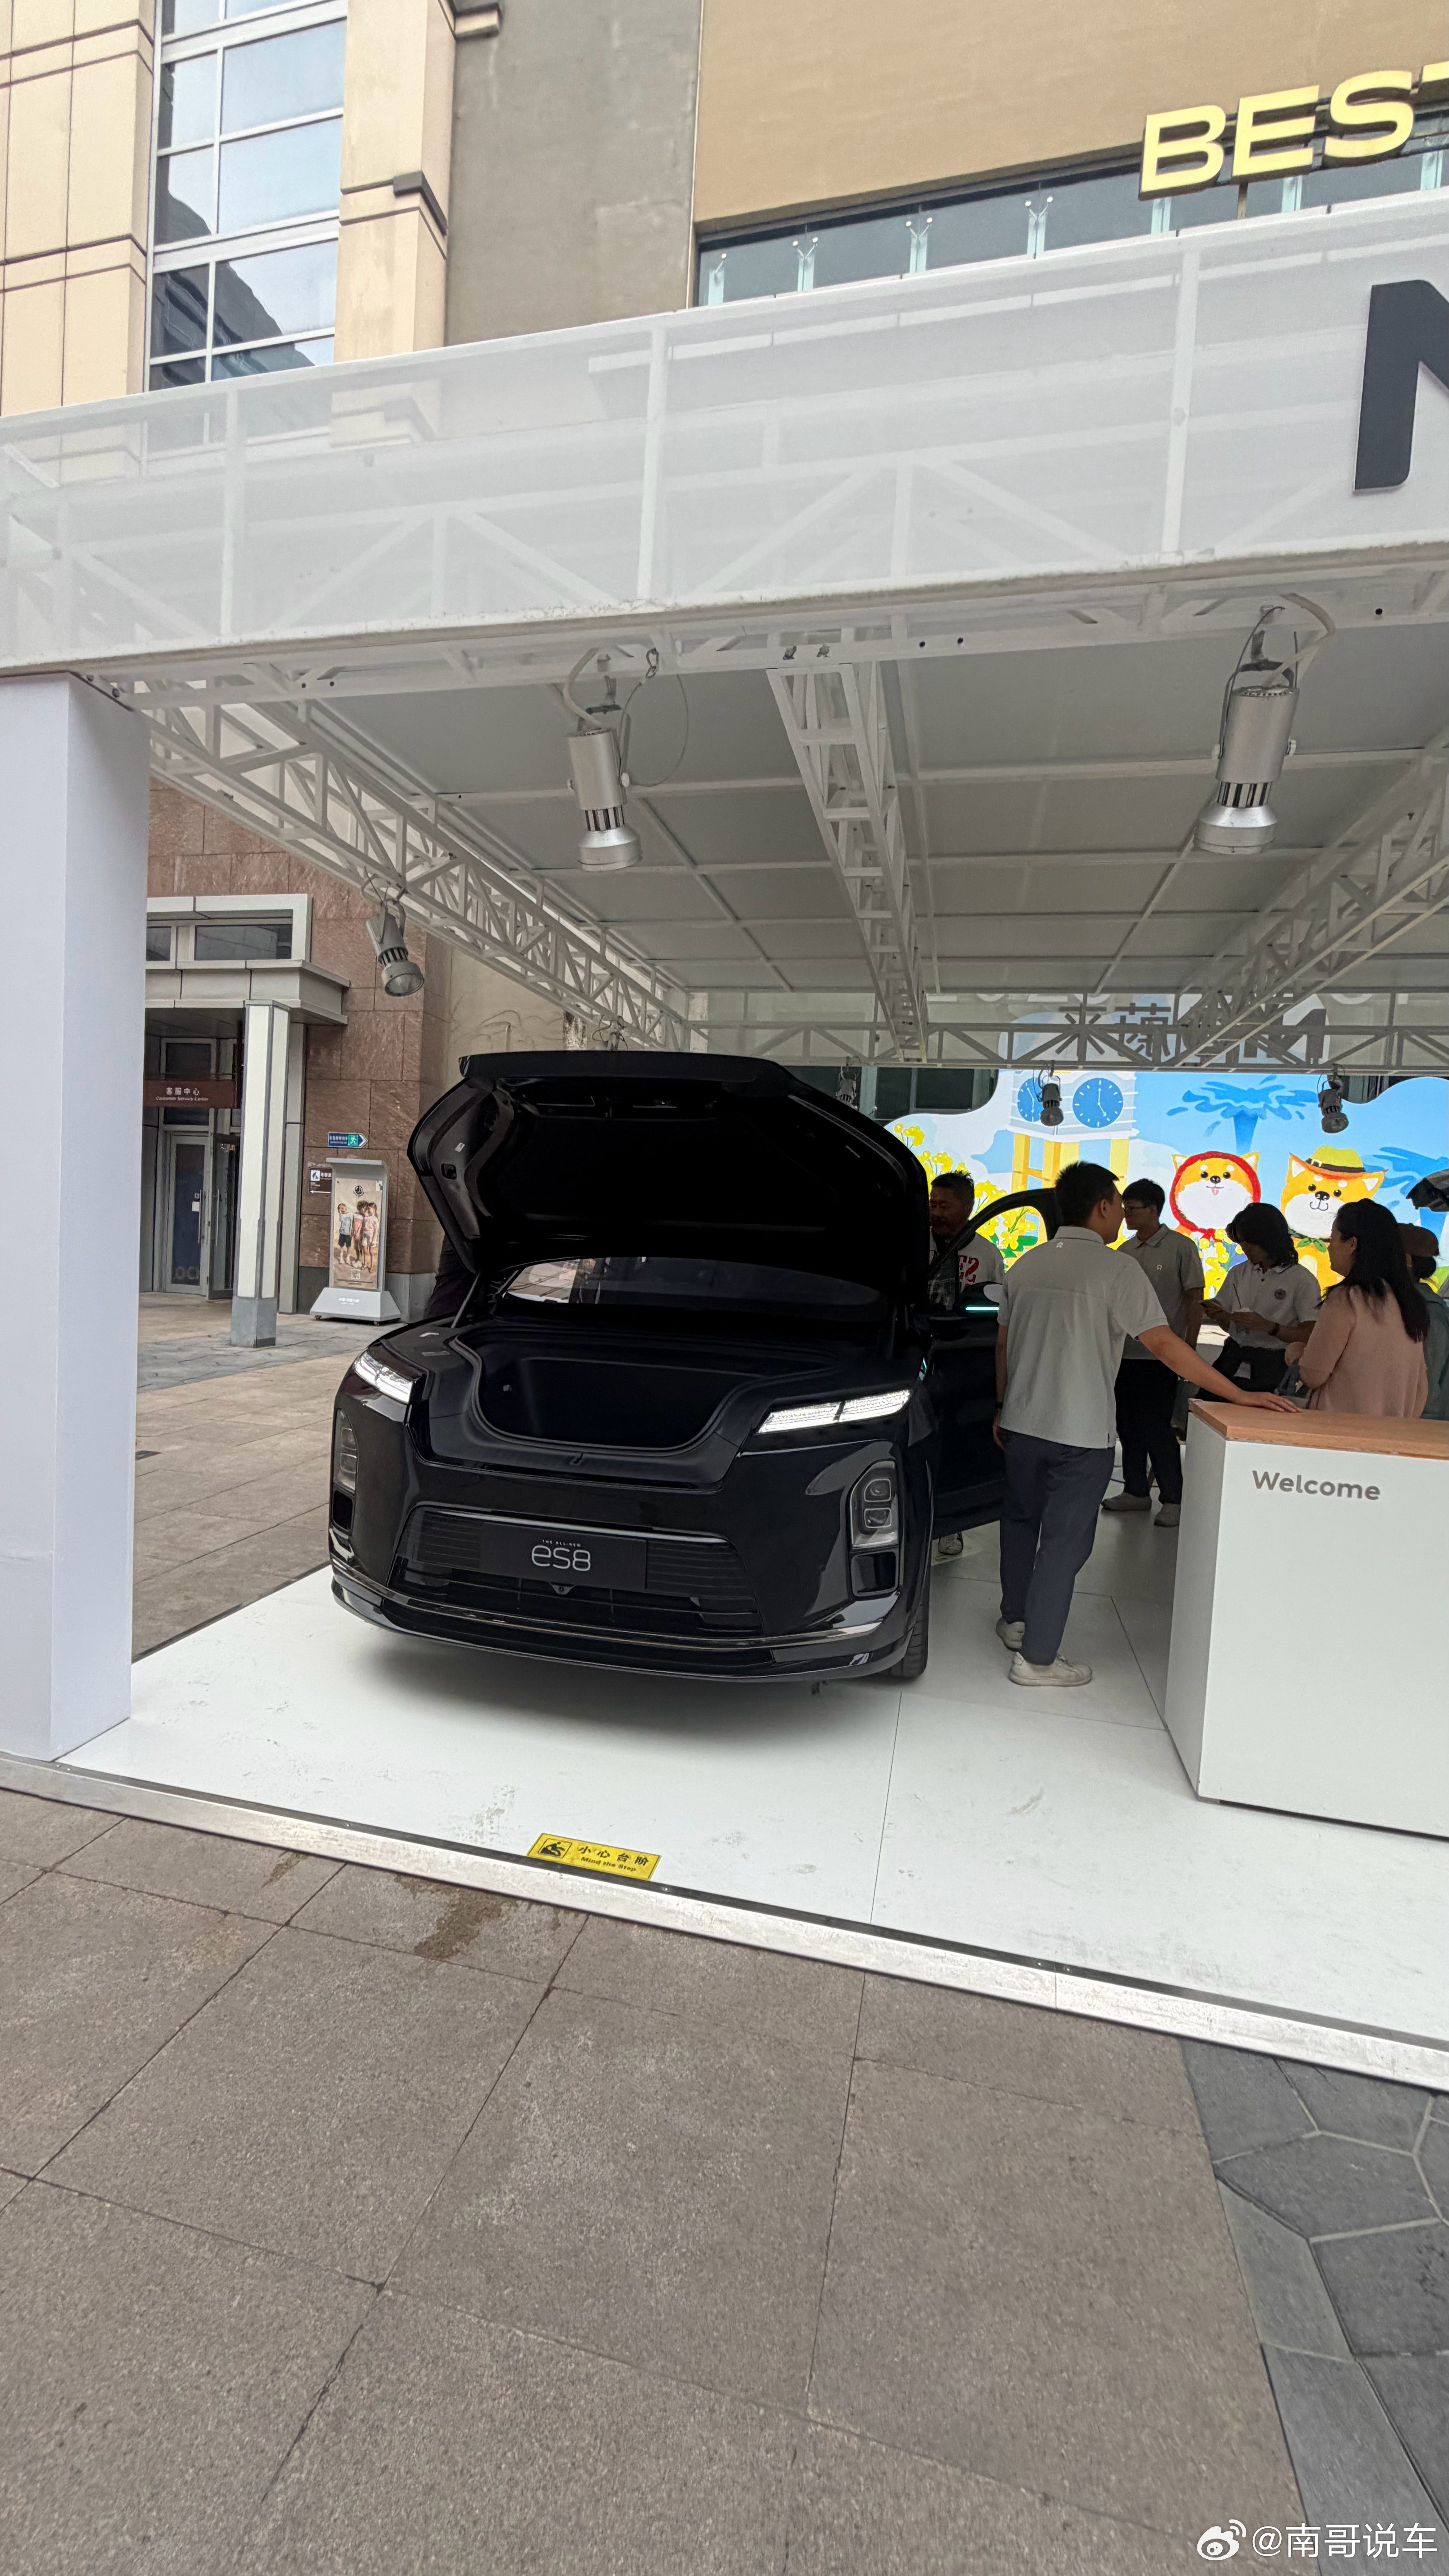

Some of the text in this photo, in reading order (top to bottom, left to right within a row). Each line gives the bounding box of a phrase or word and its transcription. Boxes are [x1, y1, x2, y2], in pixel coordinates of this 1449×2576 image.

[166, 1087, 200, 1096] 客服中心
[1251, 1470, 1381, 1501] Welcome
[578, 1846, 649, 1866] 小心台阶
[580, 1856, 602, 1865] Mind
[617, 1864, 636, 1872] Step
